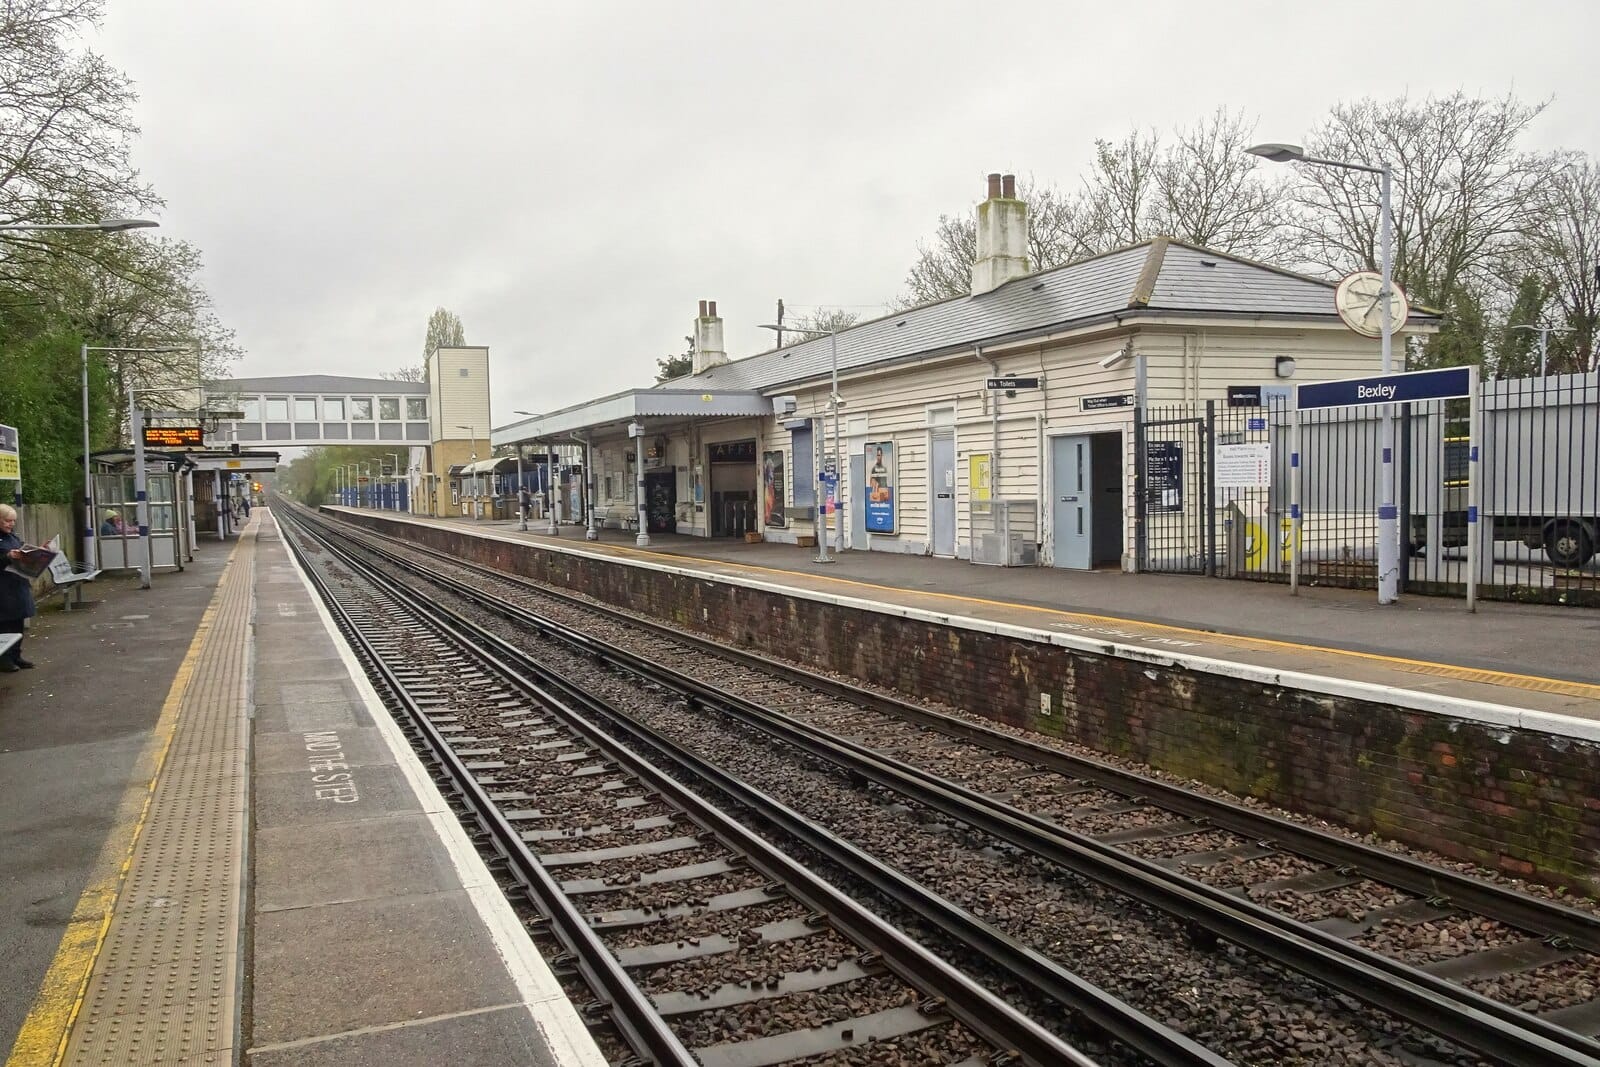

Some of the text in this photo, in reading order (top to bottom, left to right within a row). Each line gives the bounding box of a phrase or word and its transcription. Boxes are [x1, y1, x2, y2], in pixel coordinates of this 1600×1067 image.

[1358, 383, 1397, 400] Bexley
[303, 731, 359, 803] MIND THE STEP
